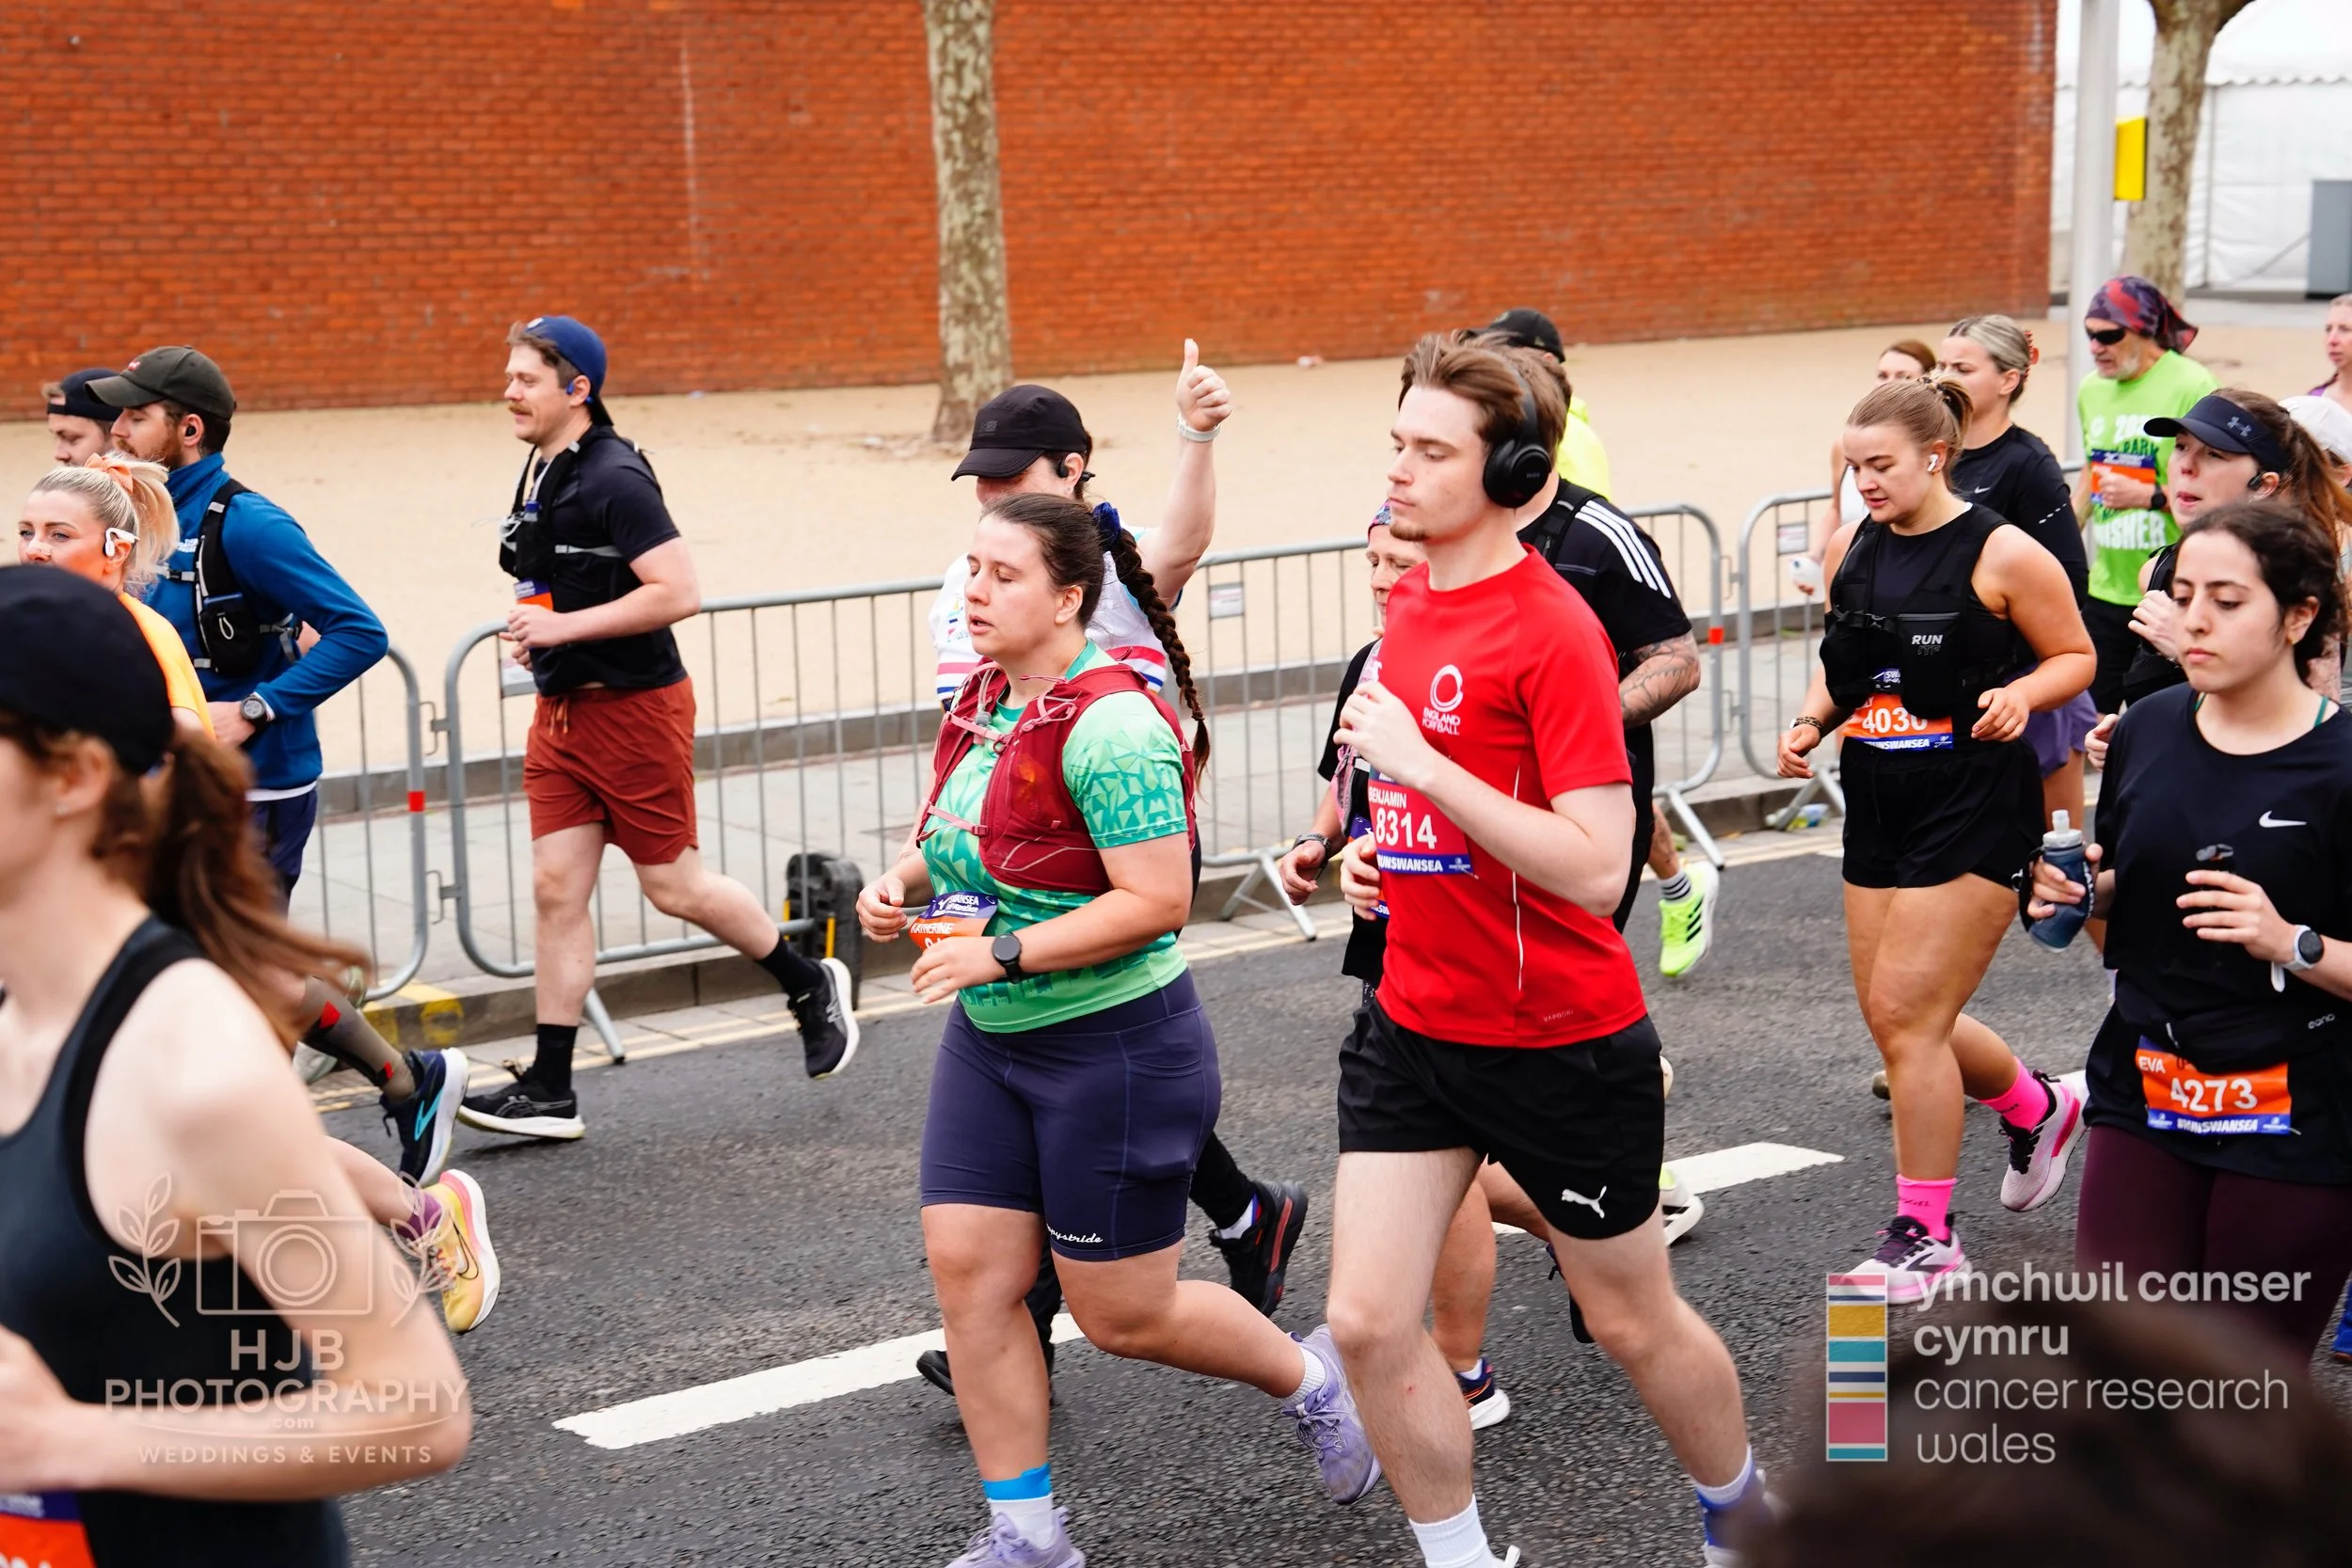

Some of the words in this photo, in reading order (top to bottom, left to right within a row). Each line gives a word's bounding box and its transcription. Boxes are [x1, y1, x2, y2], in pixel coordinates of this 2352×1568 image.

[1912, 635, 1943, 645] RUN
[1423, 706, 1461, 726] ENGLAND
[1369, 786, 1407, 809] BENJAMIN
[1375, 807, 1438, 850] 8314
[910, 922, 955, 934] KATHERINE
[2138, 1056, 2166, 1074] EVA
[2170, 1078, 2258, 1112] 4273
